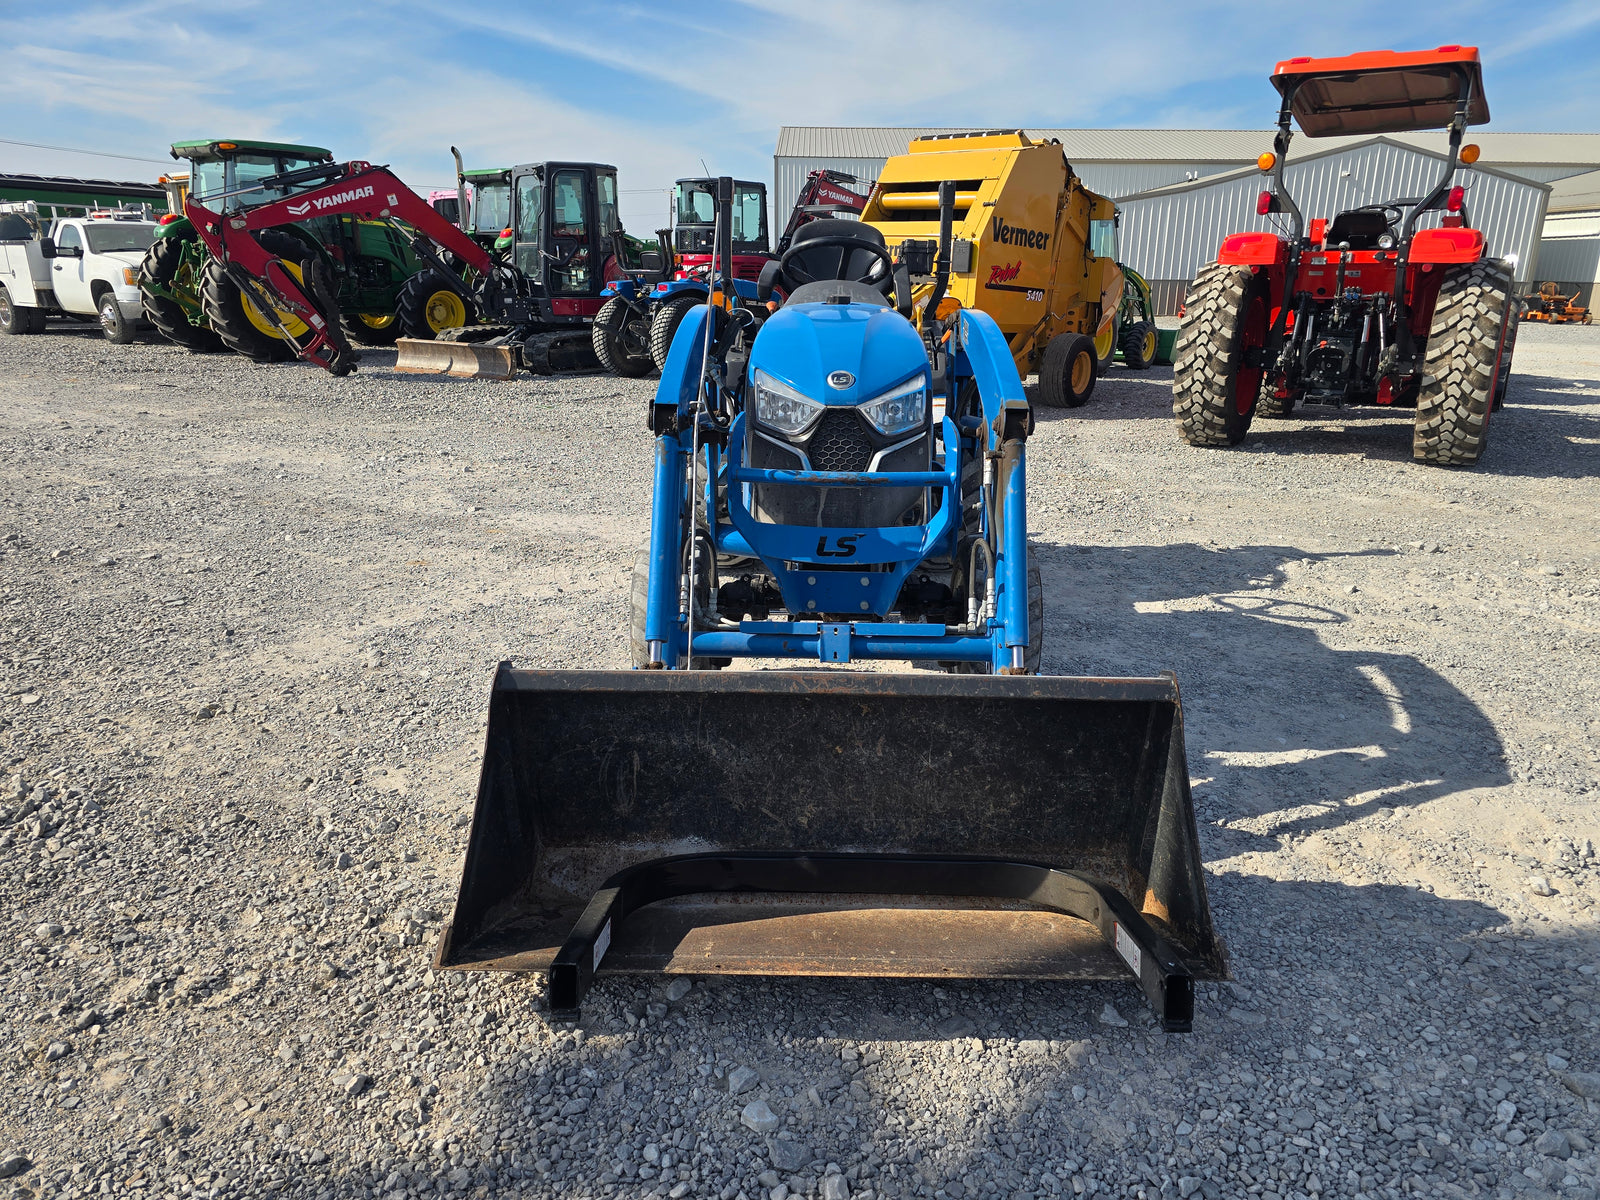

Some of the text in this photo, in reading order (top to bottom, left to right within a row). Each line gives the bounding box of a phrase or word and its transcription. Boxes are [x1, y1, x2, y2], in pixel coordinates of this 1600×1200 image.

[312, 185, 375, 210] YANMAR
[828, 190, 854, 205] YANMAR
[992, 215, 1050, 251] Vermeer
[1026, 289, 1043, 302] 5410
[816, 535, 858, 558] LS
